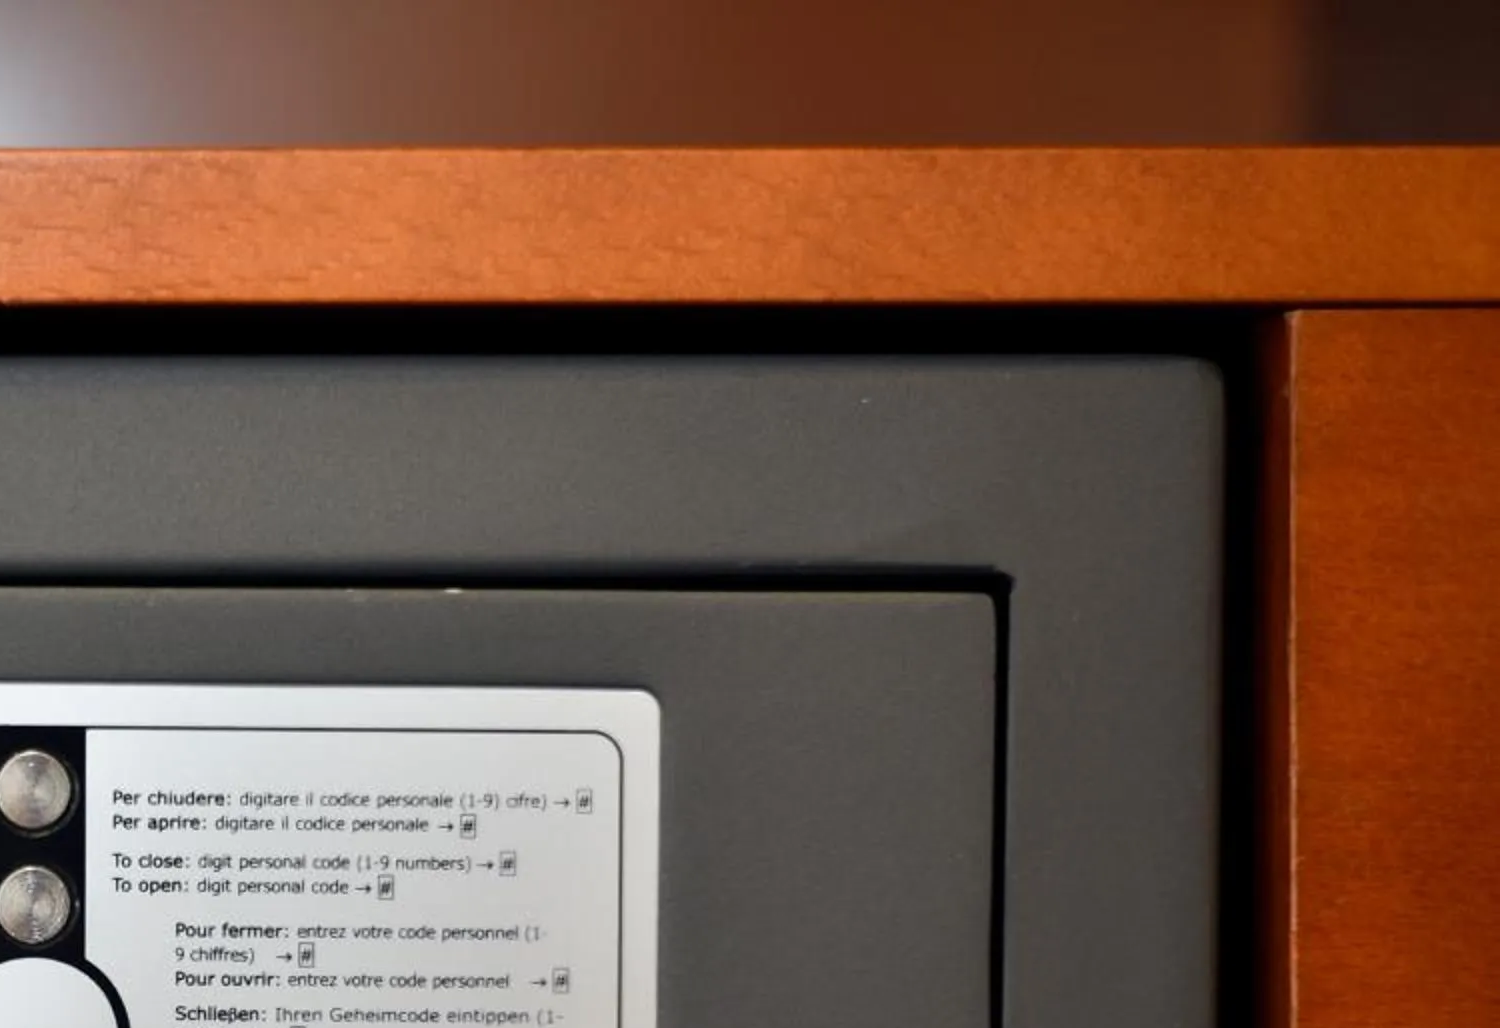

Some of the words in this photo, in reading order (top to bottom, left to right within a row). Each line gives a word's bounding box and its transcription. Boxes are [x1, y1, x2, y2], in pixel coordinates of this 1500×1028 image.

[112, 789, 142, 806] Per
[147, 789, 232, 807] chiudere:
[239, 791, 300, 811] digitare
[304, 791, 315, 808] il
[319, 791, 372, 808] codice
[375, 793, 455, 810] personale
[505, 791, 548, 812] cifre)
[112, 813, 142, 831] Per
[147, 815, 207, 833] aprire:
[214, 814, 276, 835] digitare
[280, 815, 290, 831] il
[294, 815, 347, 832] codice
[351, 817, 430, 833] personale
[112, 851, 133, 869] To
[137, 853, 191, 870] close:
[197, 853, 233, 873] digit
[238, 854, 307, 873] personal
[311, 854, 351, 871] code
[395, 855, 472, 874] numbers)
[112, 876, 133, 893] To
[137, 879, 189, 896] open:
[196, 877, 233, 897] digit
[237, 879, 306, 897] personal
[310, 879, 350, 895] code
[174, 921, 217, 939] Pour
[221, 921, 290, 940] fermer:
[295, 924, 347, 941] entrez
[351, 924, 395, 940] votre
[397, 925, 437, 941] code
[440, 925, 520, 943] personnel
[174, 946, 186, 963] 9
[188, 945, 256, 966] chiffres)
[174, 970, 217, 987] Pour
[219, 971, 281, 988] ouvrir:
[286, 972, 339, 988] entrez
[342, 973, 384, 989] votre
[388, 971, 428, 989] code
[431, 974, 511, 991] personnel
[275, 1006, 324, 1023] Ihren
[328, 1006, 442, 1024] Geheimcode
[445, 1008, 531, 1027] eintippen
